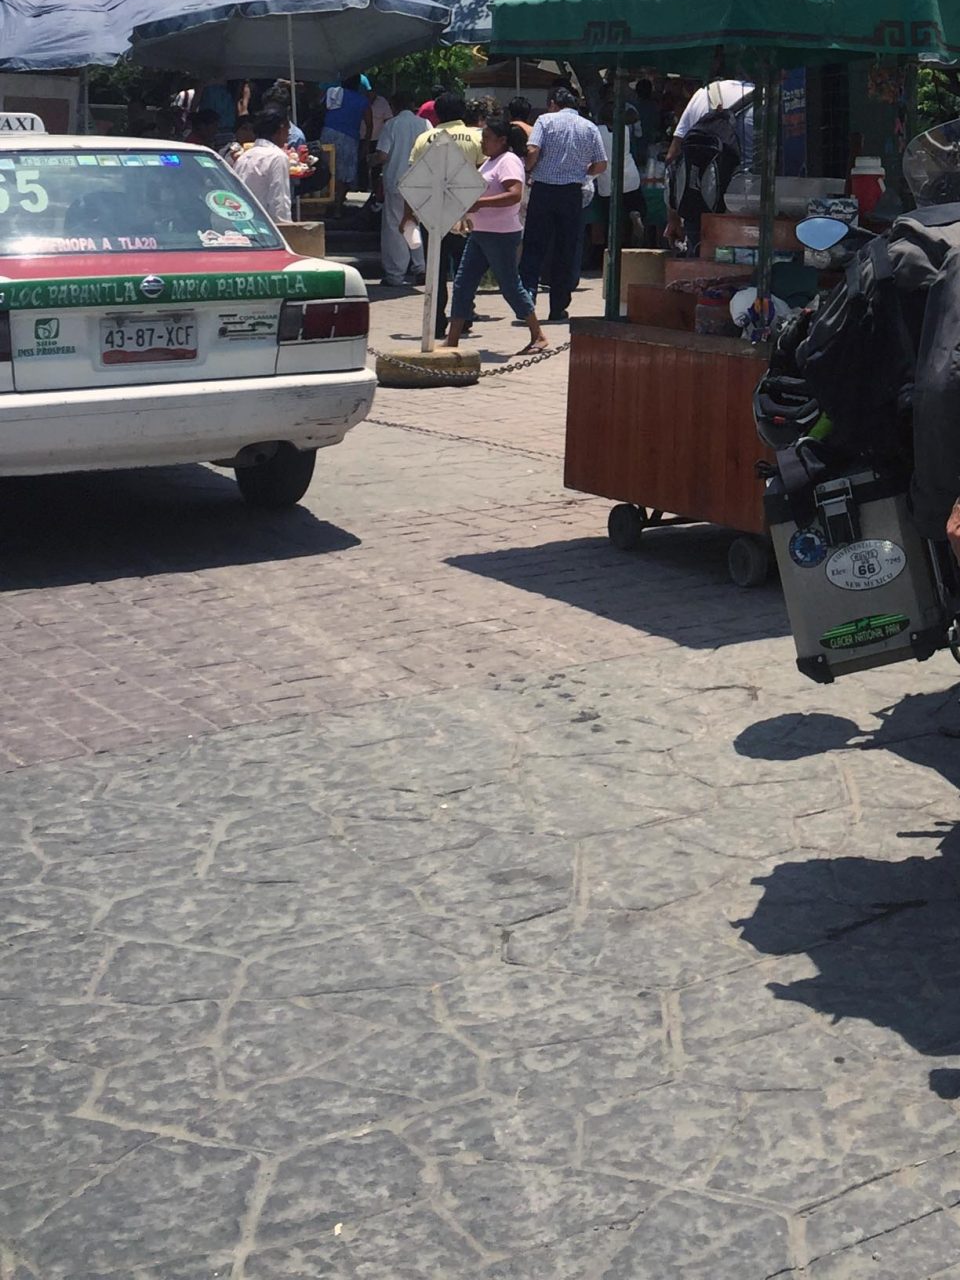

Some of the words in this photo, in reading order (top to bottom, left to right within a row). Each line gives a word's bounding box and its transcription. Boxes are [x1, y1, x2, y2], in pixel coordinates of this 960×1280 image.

[0, 117, 35, 131] AXI
[48, 281, 138, 305] PAPANTLA
[216, 274, 308, 297] PAPANTLA
[105, 325, 194, 348] 43-87-XCF
[858, 563, 877, 576] 66
[863, 572, 893, 588] MEXICO
[854, 627, 885, 643] NATIONAL
